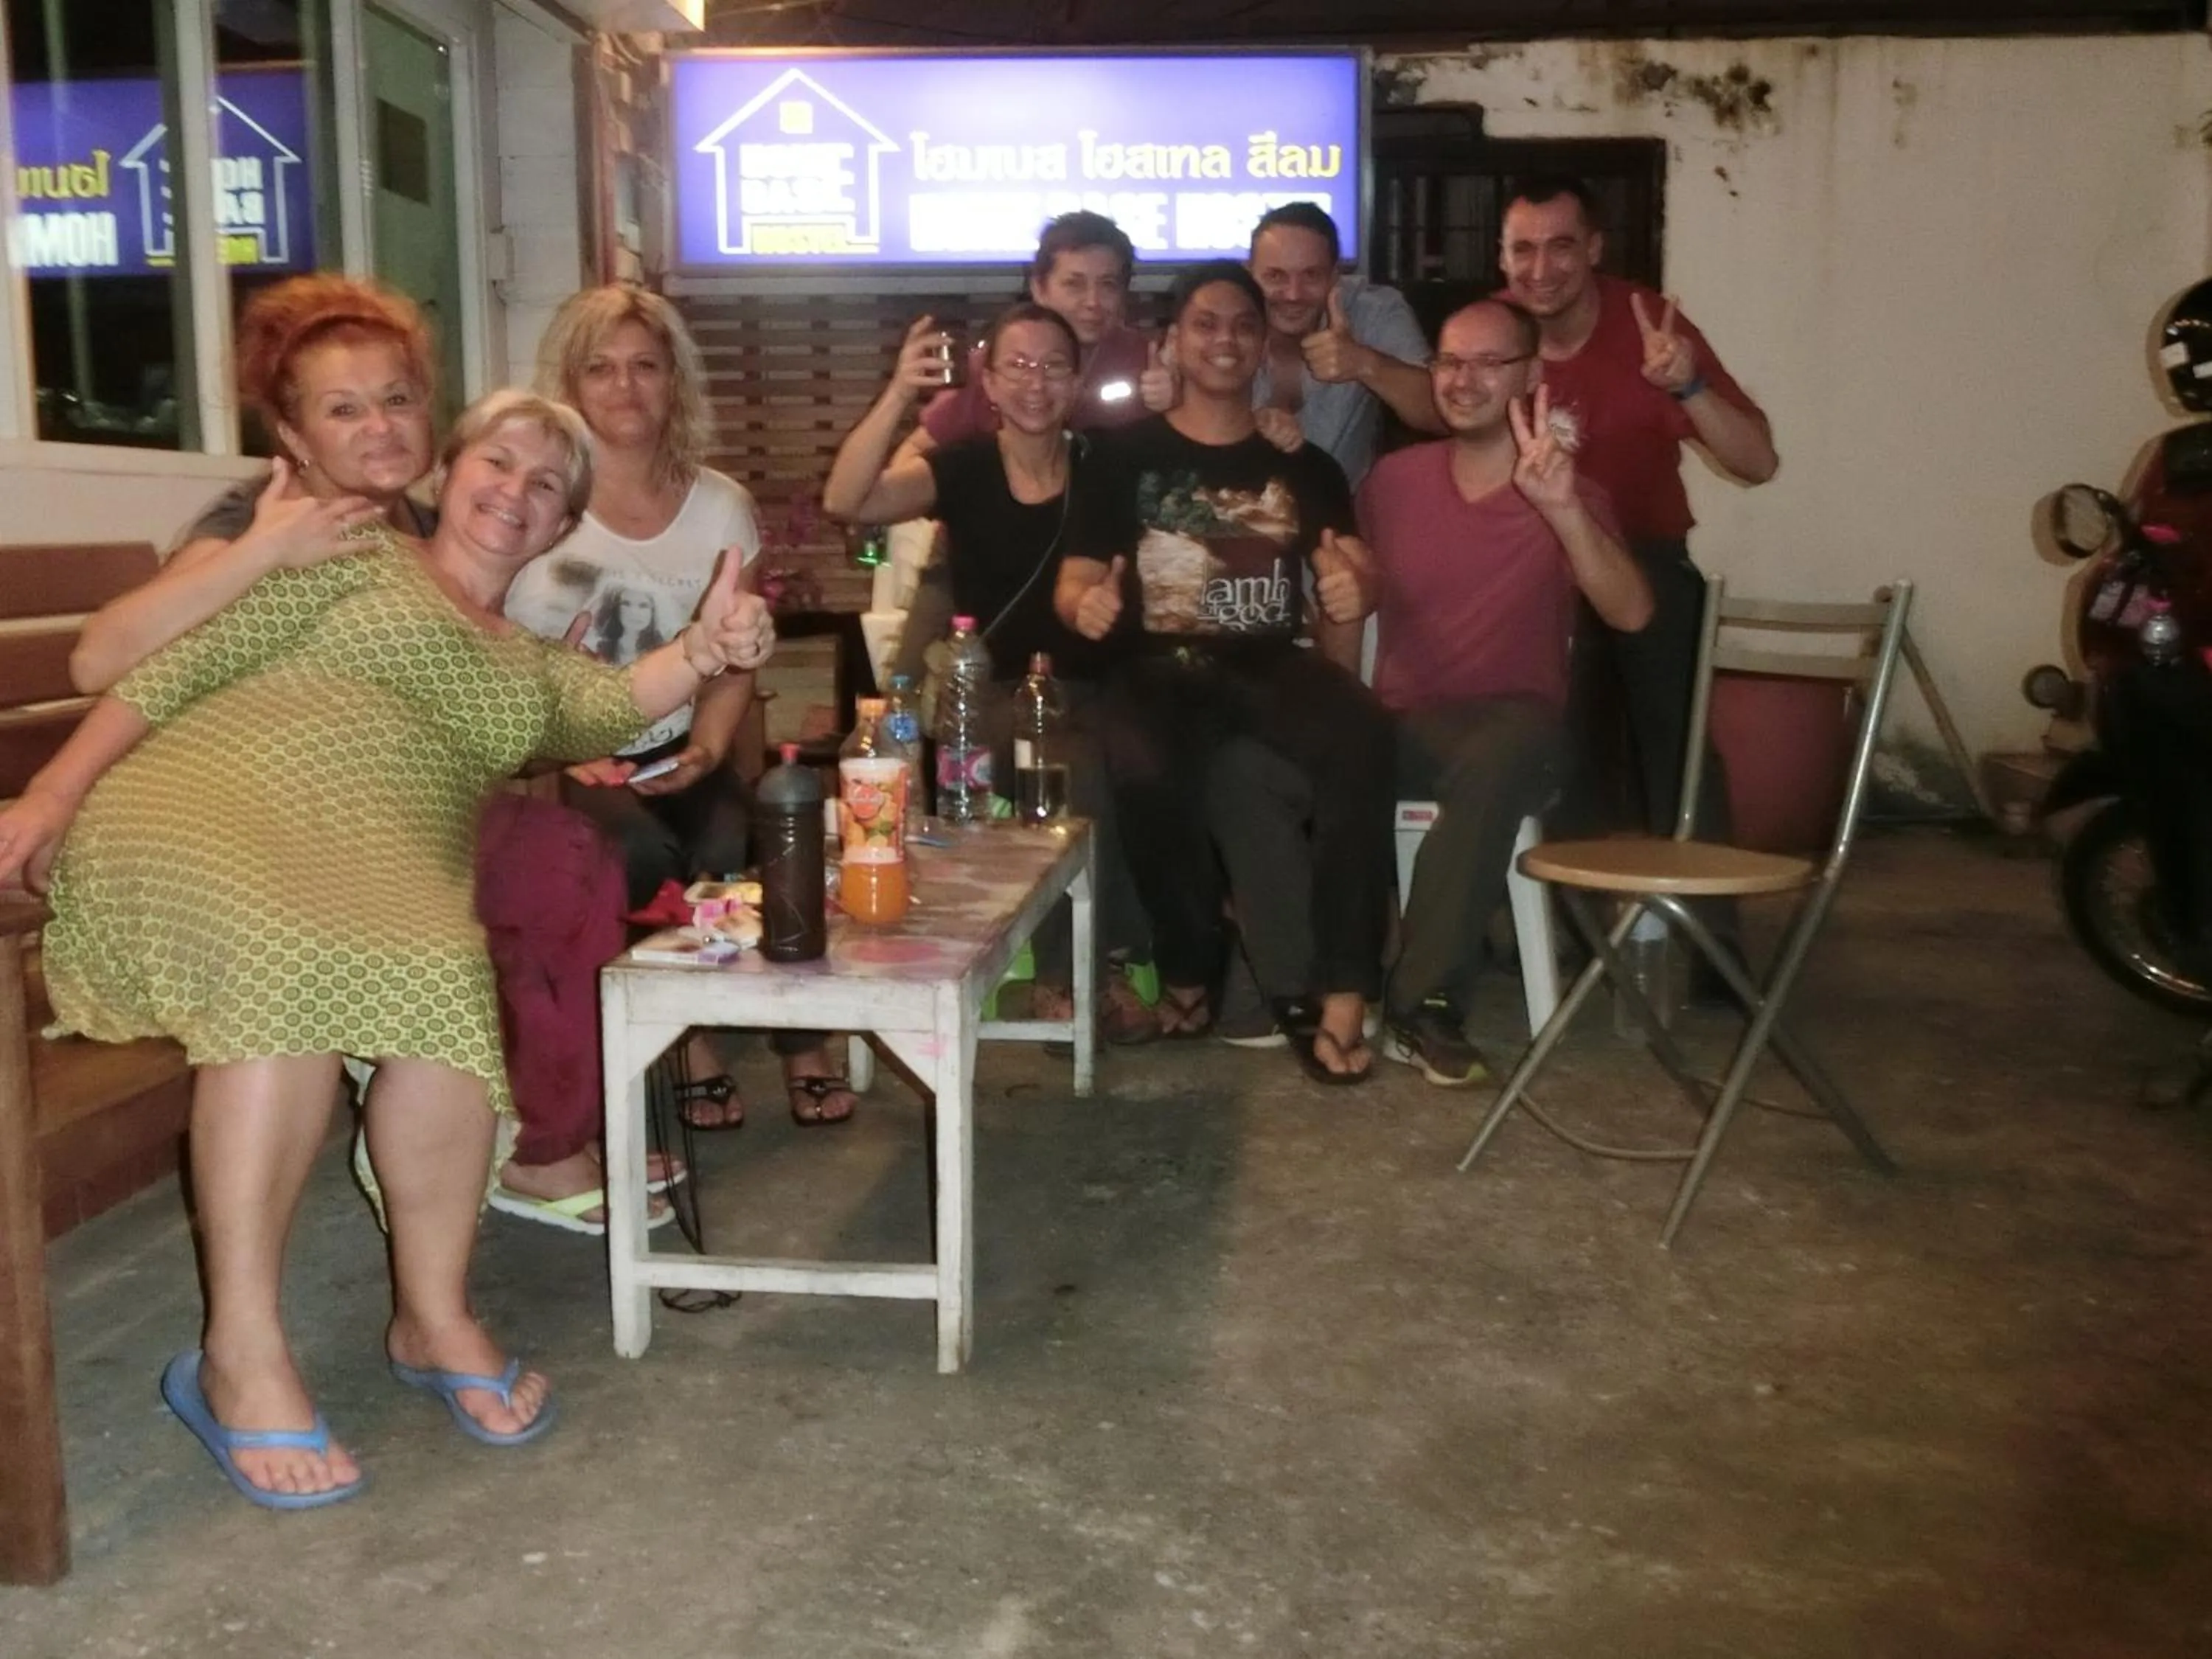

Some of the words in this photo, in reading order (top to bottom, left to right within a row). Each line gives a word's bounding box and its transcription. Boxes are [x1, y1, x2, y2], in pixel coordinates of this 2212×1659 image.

[1247, 131, 1340, 178] สีลม
[1200, 557, 1291, 606] lamb
[1219, 585, 1291, 631] god
